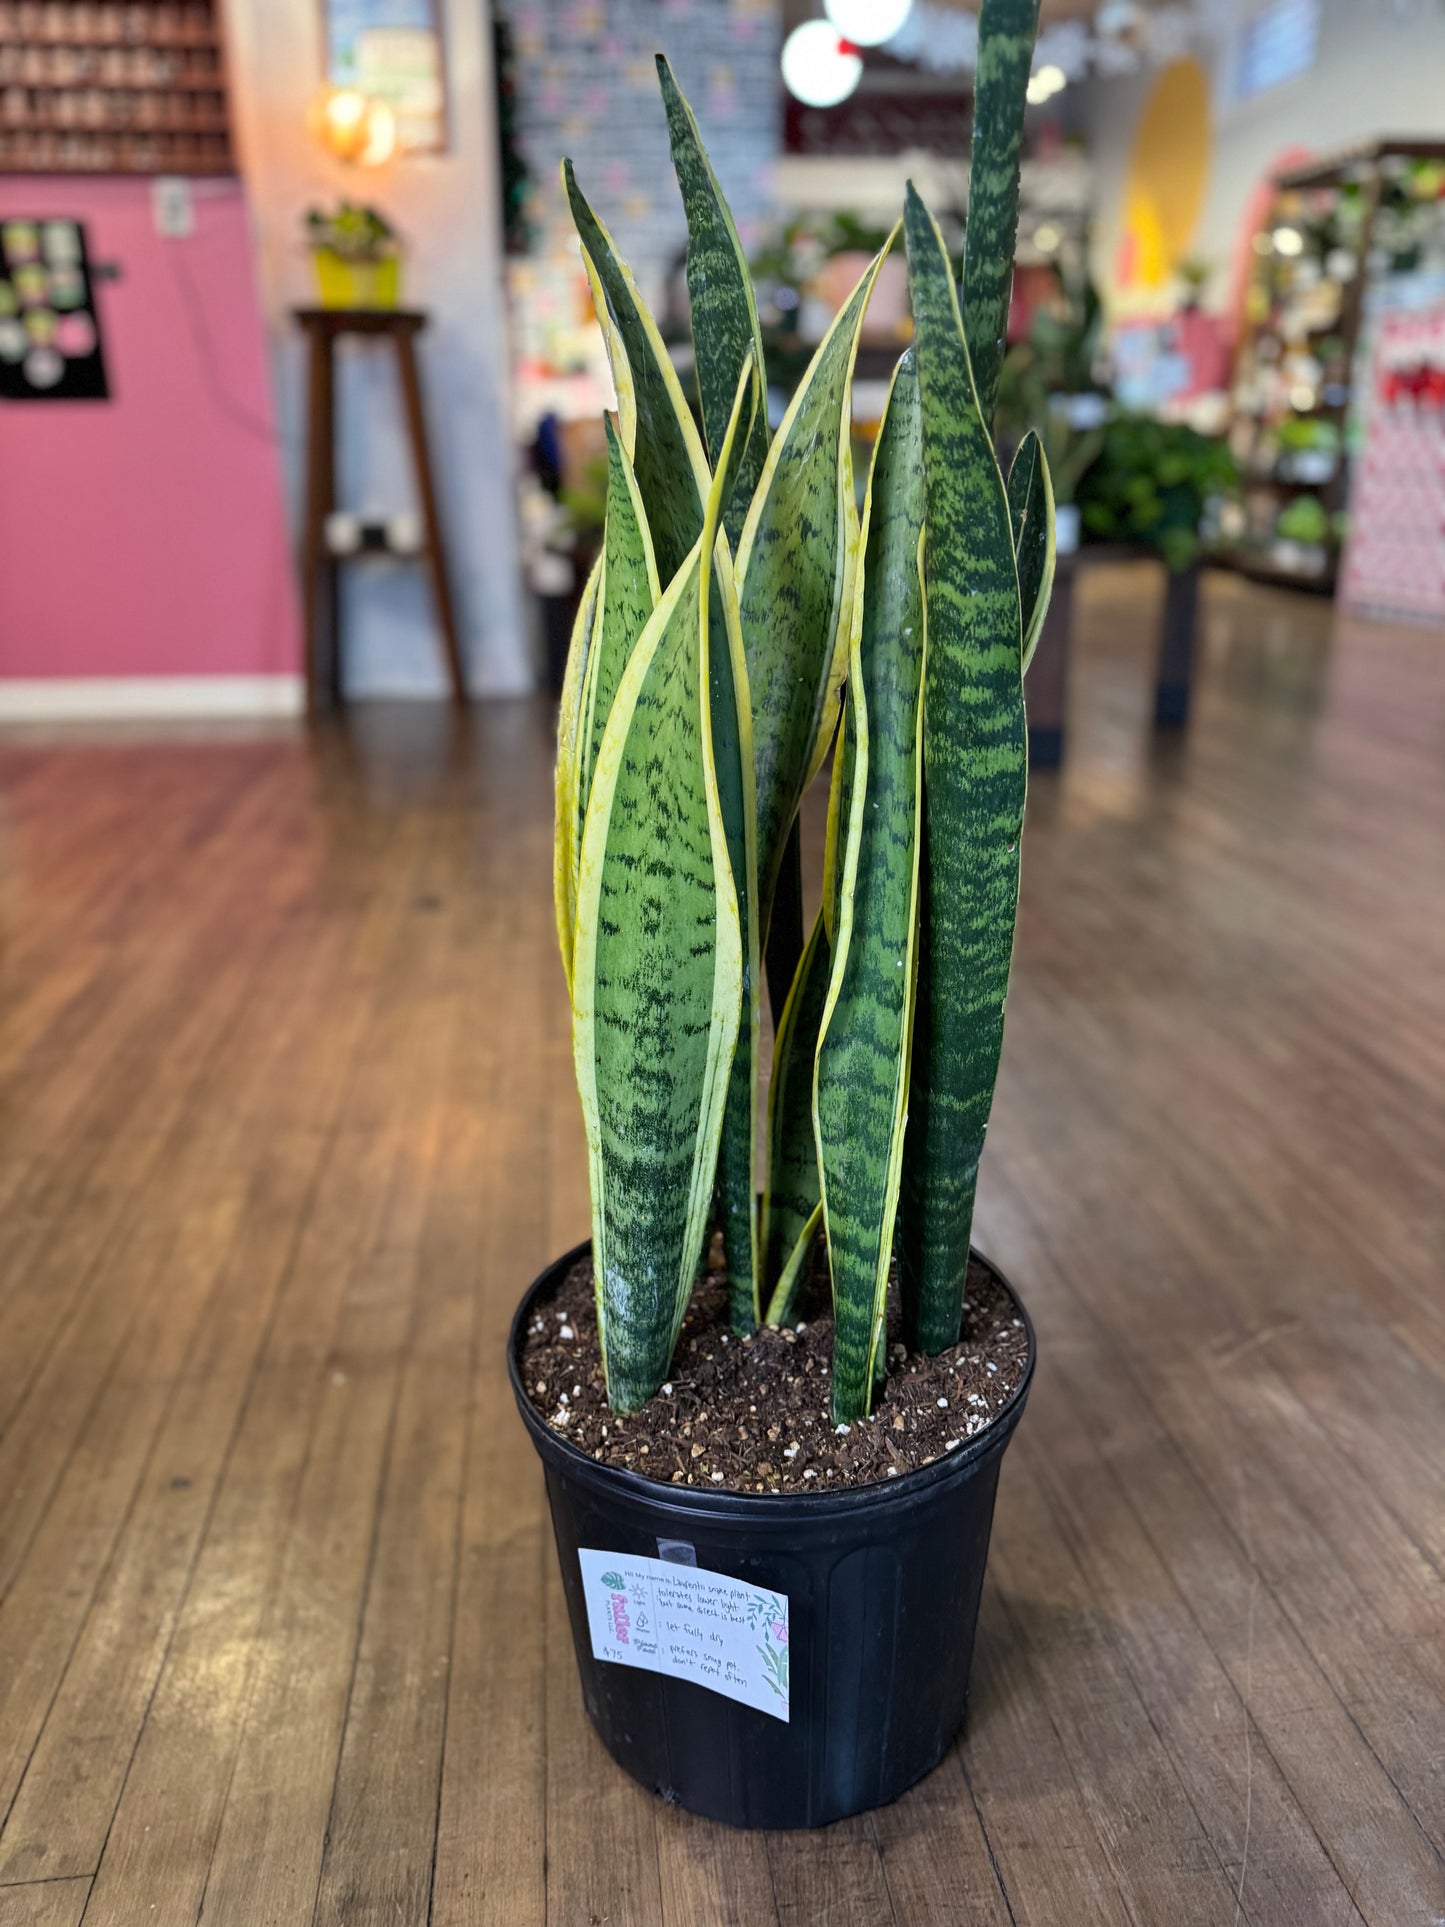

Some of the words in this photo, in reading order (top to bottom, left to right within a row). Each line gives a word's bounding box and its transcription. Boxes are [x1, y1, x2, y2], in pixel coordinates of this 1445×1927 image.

[635, 1572, 645, 1580] My
[646, 1575, 665, 1583] name
[658, 1587, 692, 1602] tolerates
[697, 1593, 717, 1605] lower
[720, 1599, 739, 1614] light
[708, 1585, 727, 1596] snake
[730, 1590, 751, 1600] plant
[660, 1599, 674, 1608] but
[676, 1602, 693, 1612] some
[697, 1604, 719, 1617] direct
[721, 1613, 727, 1621] is
[730, 1615, 745, 1624] best
[666, 1621, 680, 1632] let
[683, 1623, 703, 1641] fully
[709, 1632, 723, 1647] dry
[603, 1646, 623, 1660] $75
[669, 1644, 698, 1658] prefers
[703, 1653, 722, 1668] snug
[672, 1655, 696, 1666] don't
[700, 1663, 720, 1677] repot
[724, 1671, 748, 1688] often
